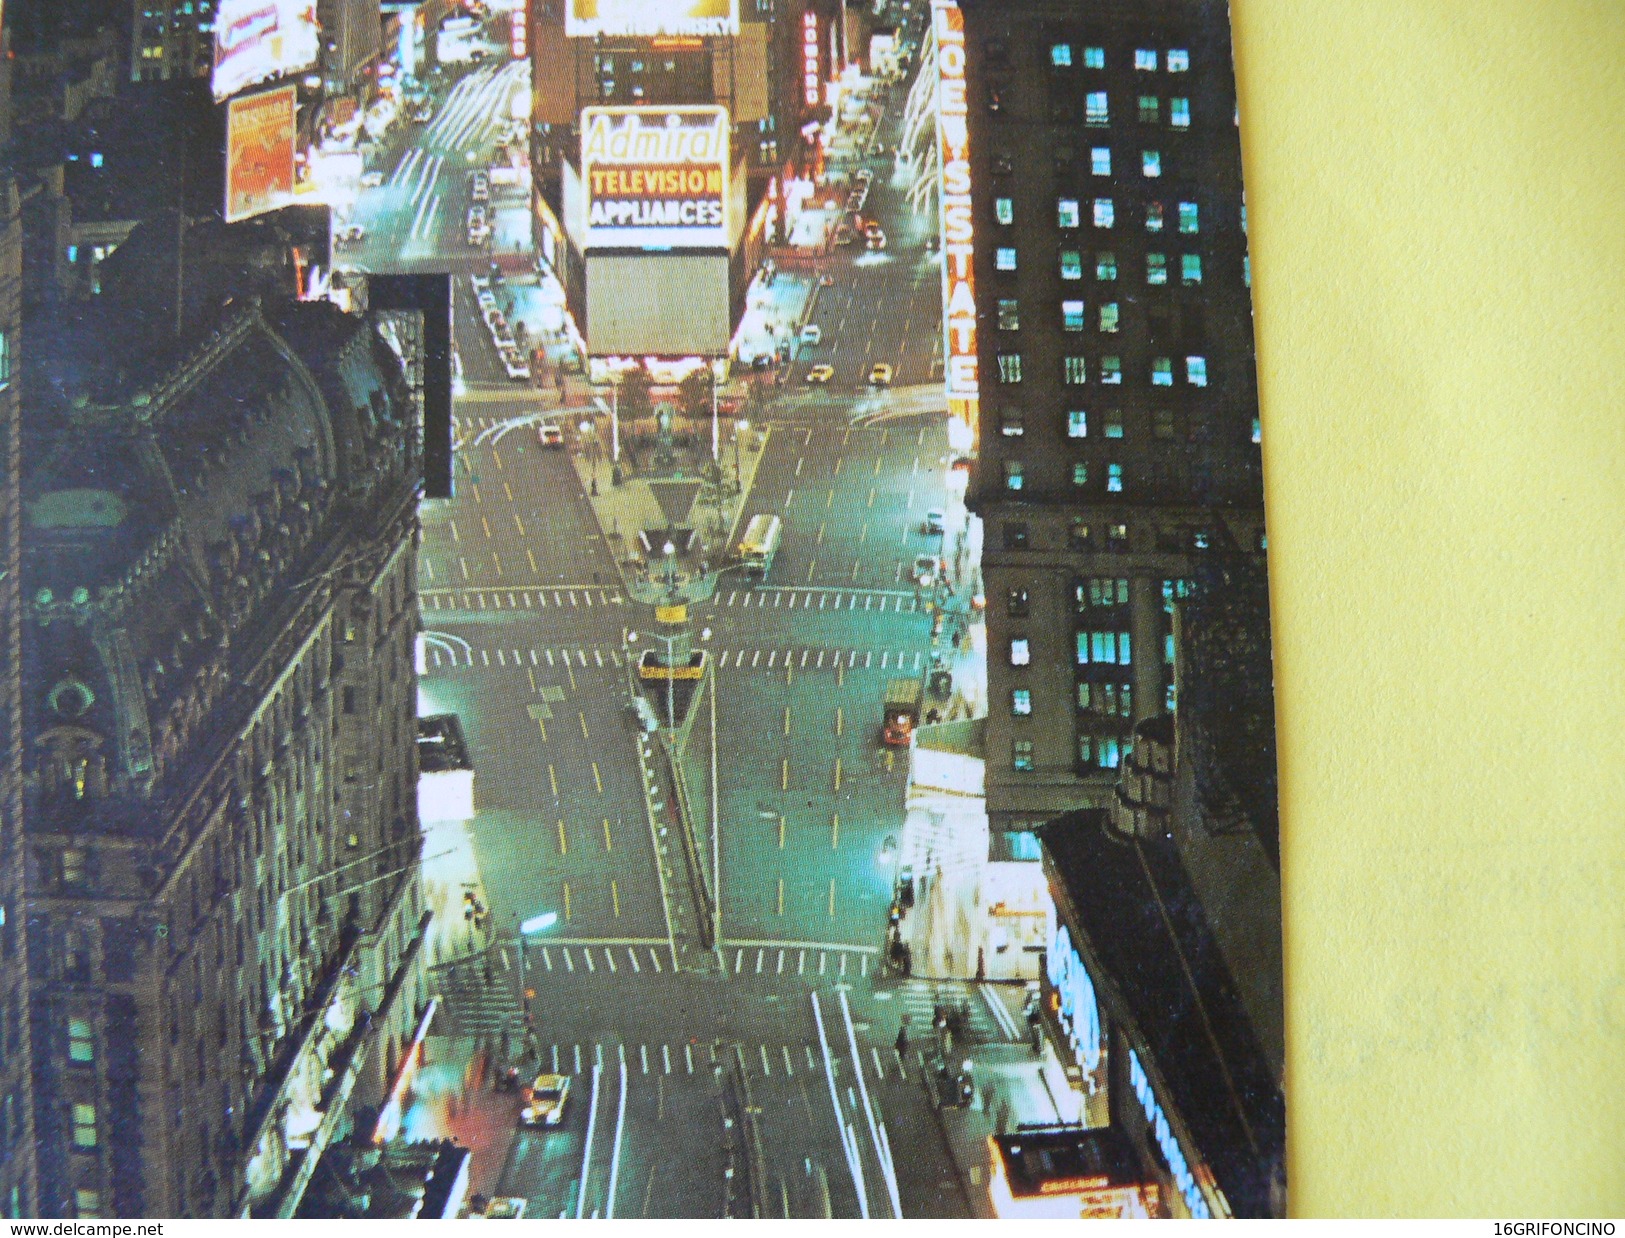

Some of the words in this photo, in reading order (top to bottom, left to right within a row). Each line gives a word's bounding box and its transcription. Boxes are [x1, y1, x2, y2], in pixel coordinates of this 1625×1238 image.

[584, 114, 725, 160] Admiral
[592, 169, 722, 194] TELEVISION
[590, 199, 722, 225] APPLIANCES
[945, 206, 979, 392] STATE
